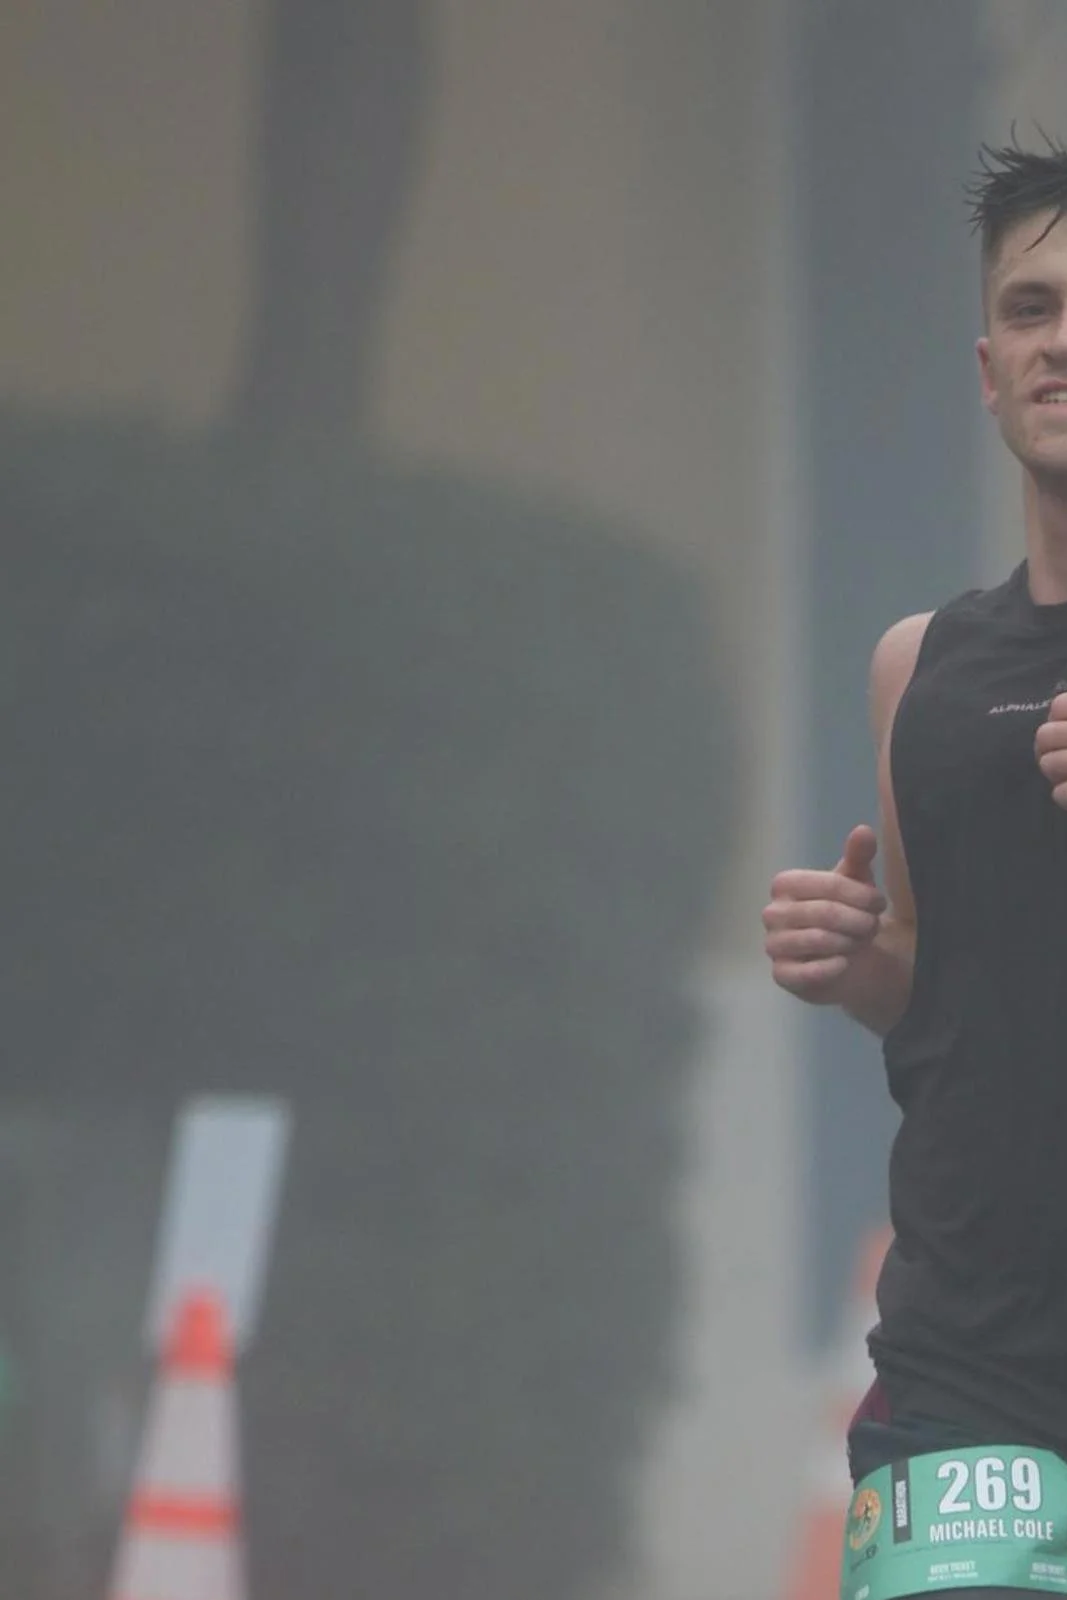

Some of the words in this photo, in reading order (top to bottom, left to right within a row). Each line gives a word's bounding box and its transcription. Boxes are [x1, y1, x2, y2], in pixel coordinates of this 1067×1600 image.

[937, 1457, 1041, 1514] 269
[929, 1518, 1008, 1544] MICHAEL
[1013, 1518, 1055, 1542] COLE
